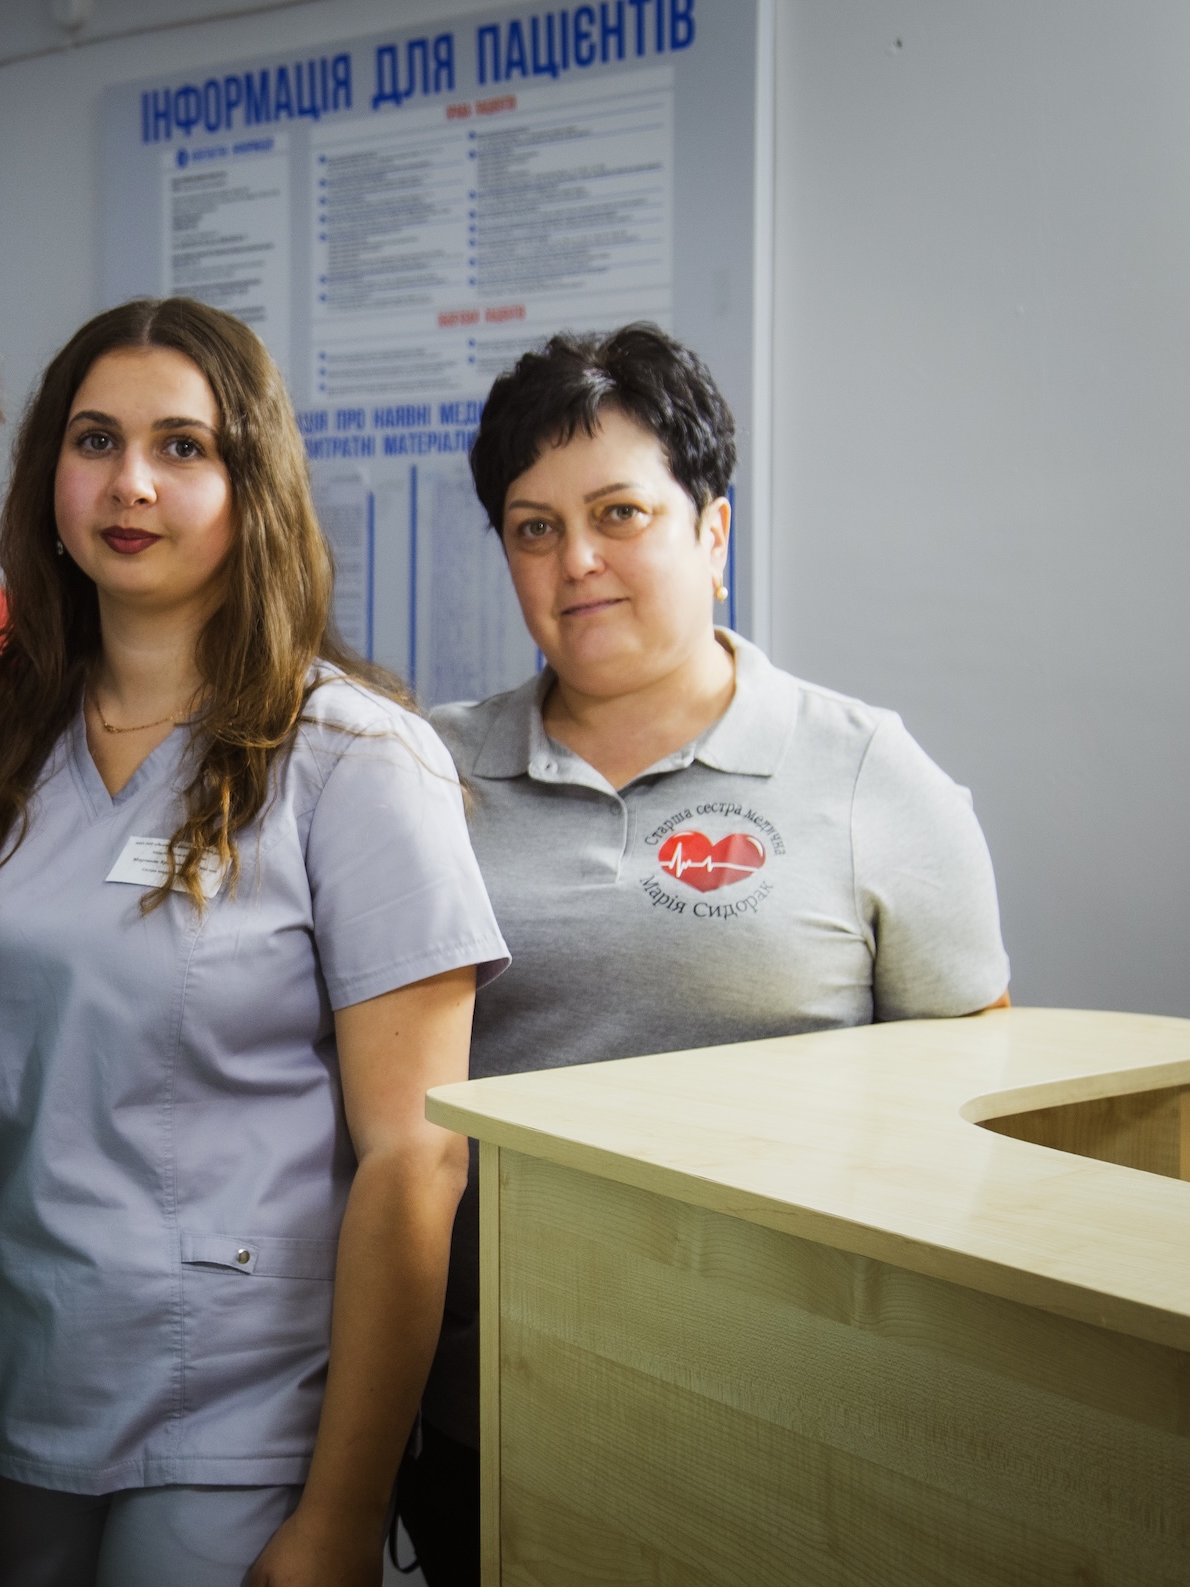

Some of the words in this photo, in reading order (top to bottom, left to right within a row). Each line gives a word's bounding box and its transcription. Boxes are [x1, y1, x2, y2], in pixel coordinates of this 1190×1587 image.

[141, 52, 352, 144] ІНФОРМАЦІЯ
[371, 33, 455, 111] ДЛЯ
[476, 0, 696, 87] ПАЦІЄНТІВ
[336, 407, 366, 431] ПРО
[374, 403, 431, 429] НАЯВНІ
[644, 808, 693, 846] Старша
[696, 802, 742, 817] сестра
[742, 808, 786, 856] медична
[639, 875, 687, 914] Марія
[693, 880, 774, 920] Сидорак
